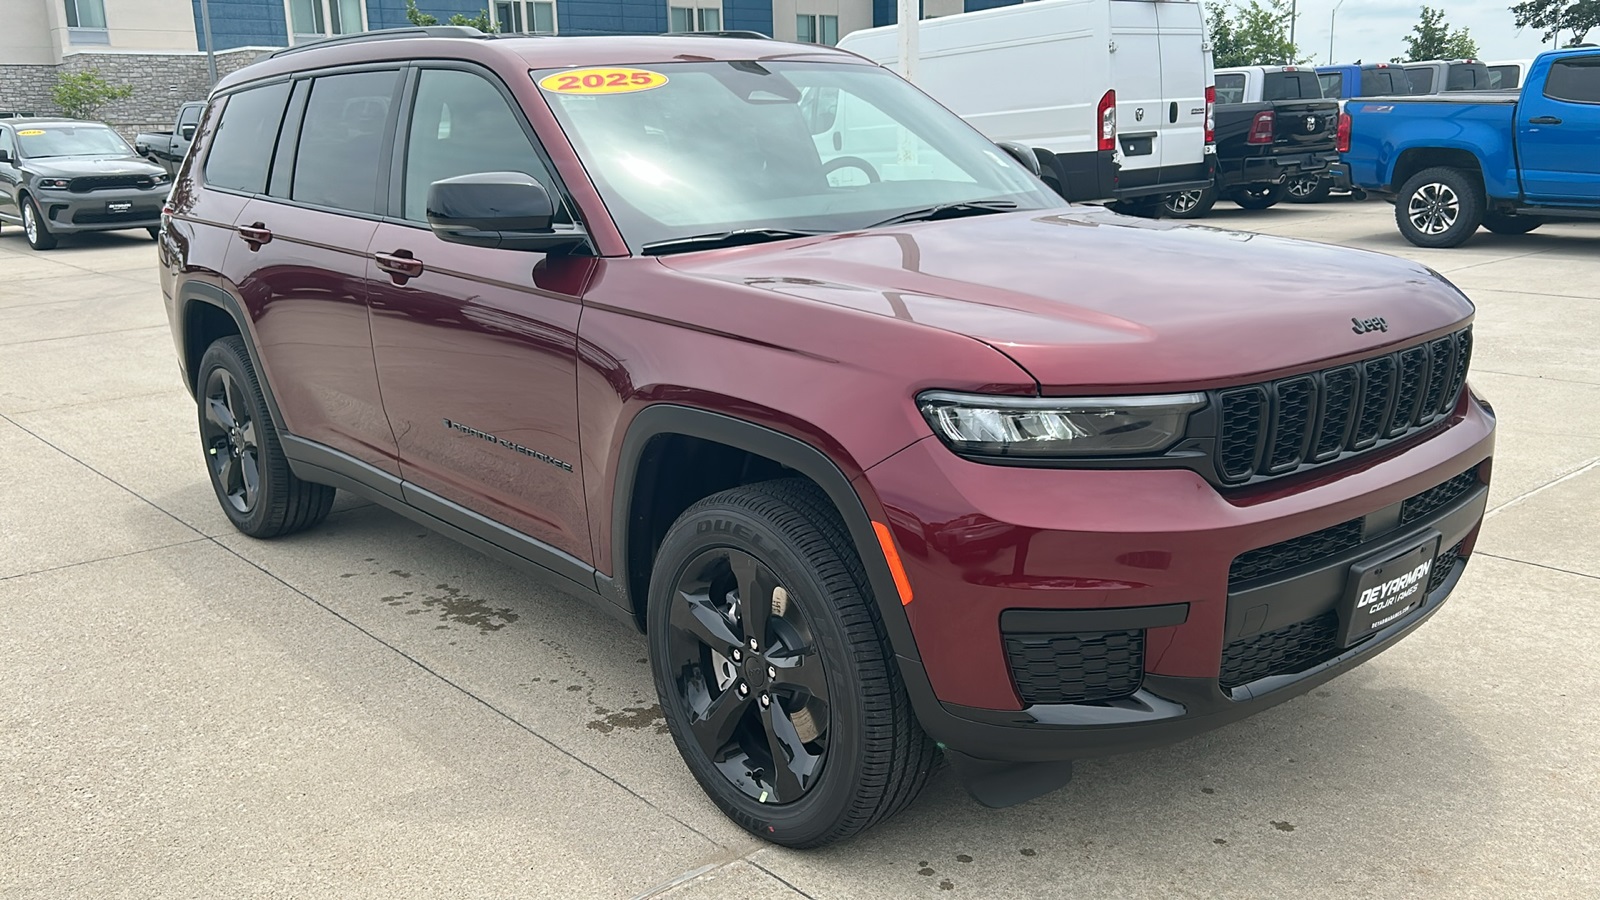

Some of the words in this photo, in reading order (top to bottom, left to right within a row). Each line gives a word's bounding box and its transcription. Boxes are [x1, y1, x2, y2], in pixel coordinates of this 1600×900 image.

[557, 72, 653, 90] 2025
[1351, 317, 1387, 334] Jeep
[453, 422, 497, 443] GRAND
[499, 438, 573, 473] CHEROKEE
[1357, 558, 1432, 608] DEYARMAN
